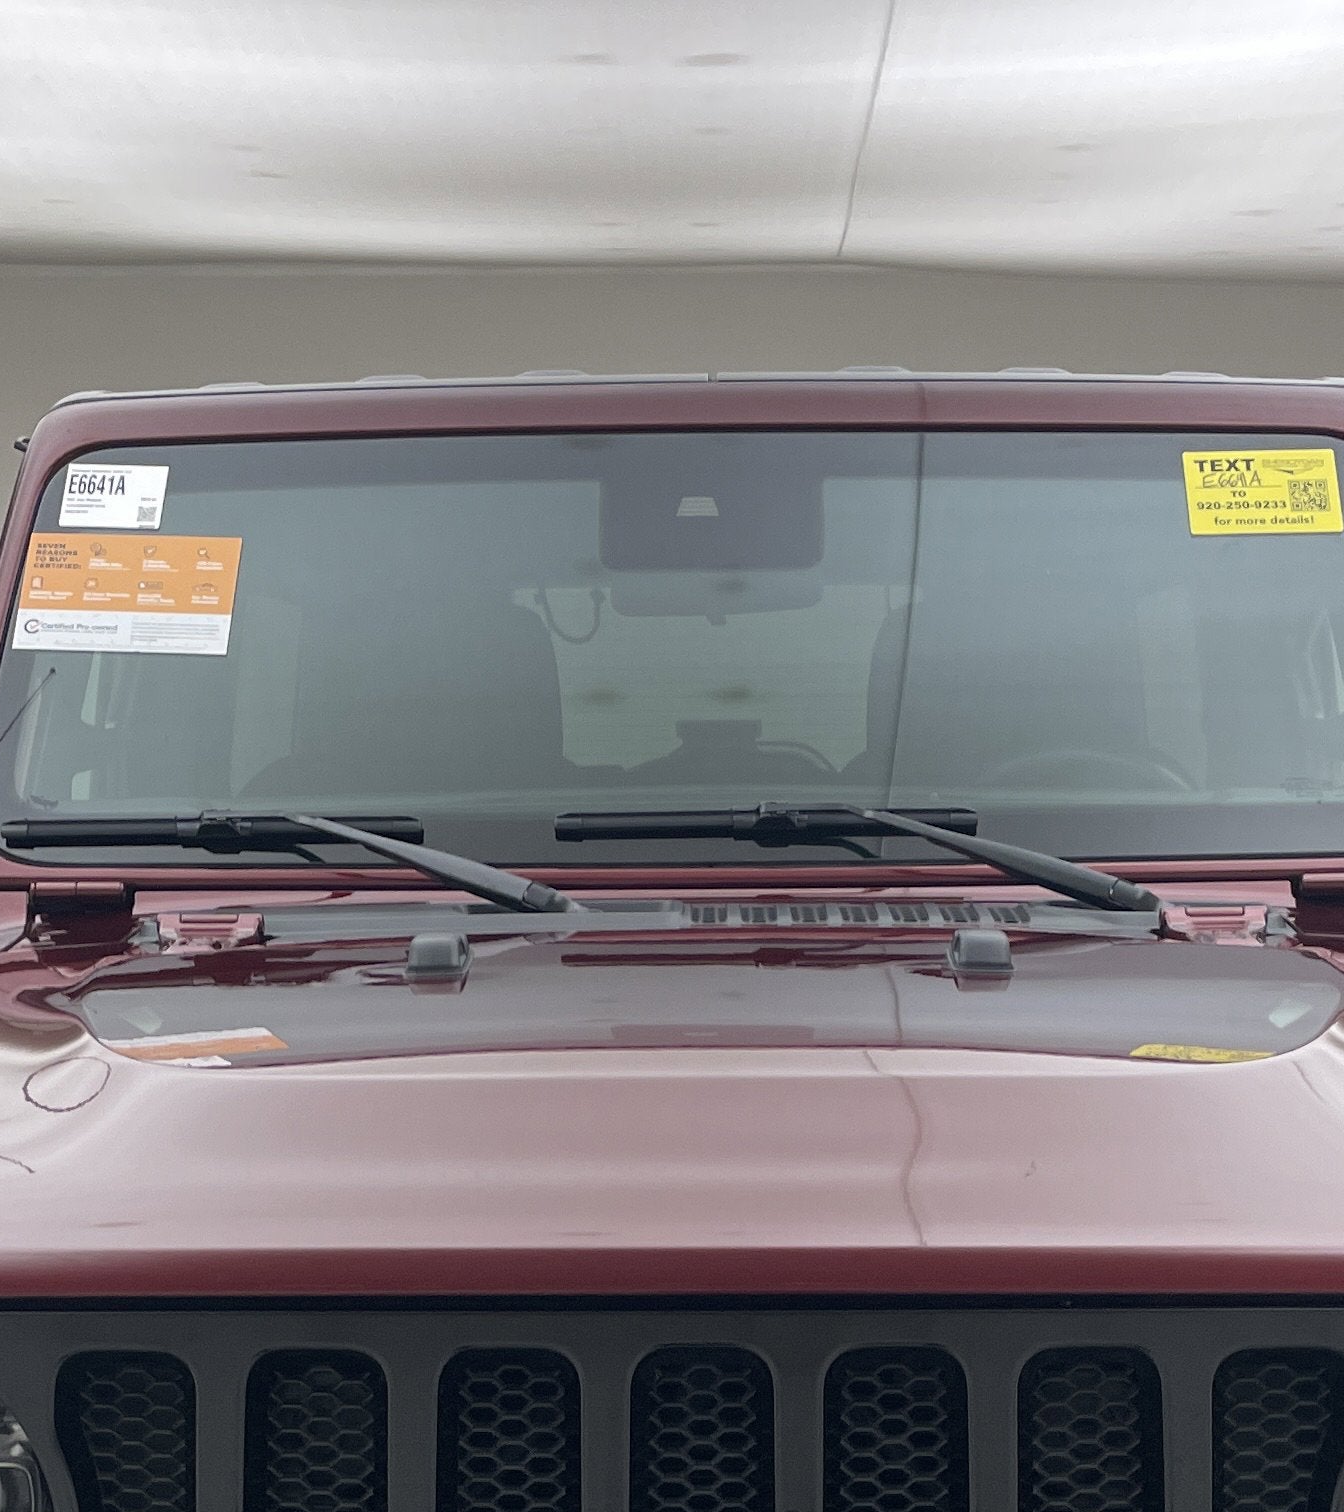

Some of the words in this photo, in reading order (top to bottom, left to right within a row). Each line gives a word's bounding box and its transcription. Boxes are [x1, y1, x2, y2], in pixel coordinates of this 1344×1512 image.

[1194, 458, 1255, 472] TEXT
[68, 473, 125, 495] E6641A
[1230, 490, 1247, 498] TO
[1214, 516, 1232, 525] for
[1236, 517, 1266, 525] more
[1270, 515, 1314, 525] details!
